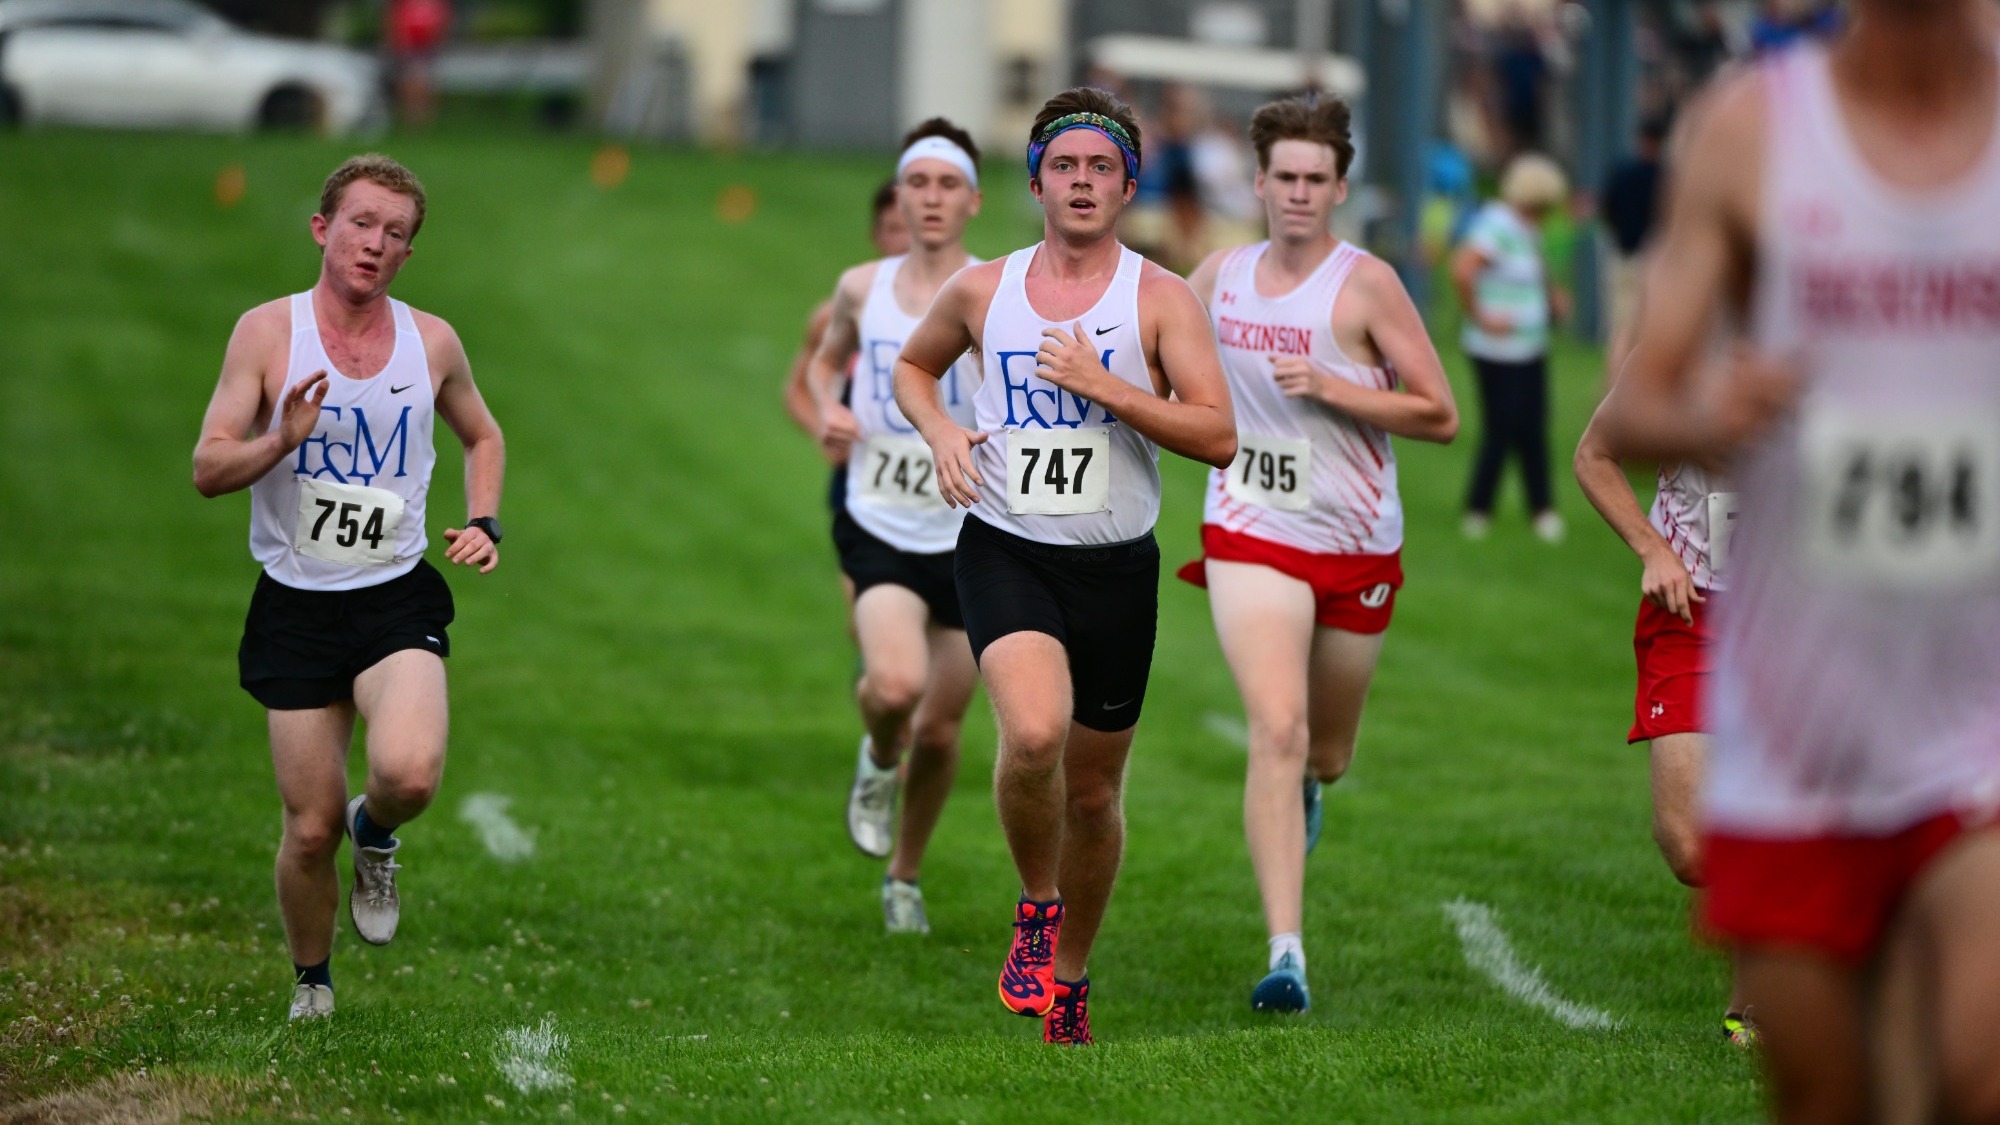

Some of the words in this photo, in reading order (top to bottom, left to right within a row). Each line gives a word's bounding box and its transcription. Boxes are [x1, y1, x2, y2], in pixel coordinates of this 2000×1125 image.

[1218, 316, 1312, 356] DICKINSON
[873, 451, 933, 496] 742
[1020, 448, 1094, 495] 747
[1241, 447, 1296, 493] 795
[310, 498, 385, 549] 754
